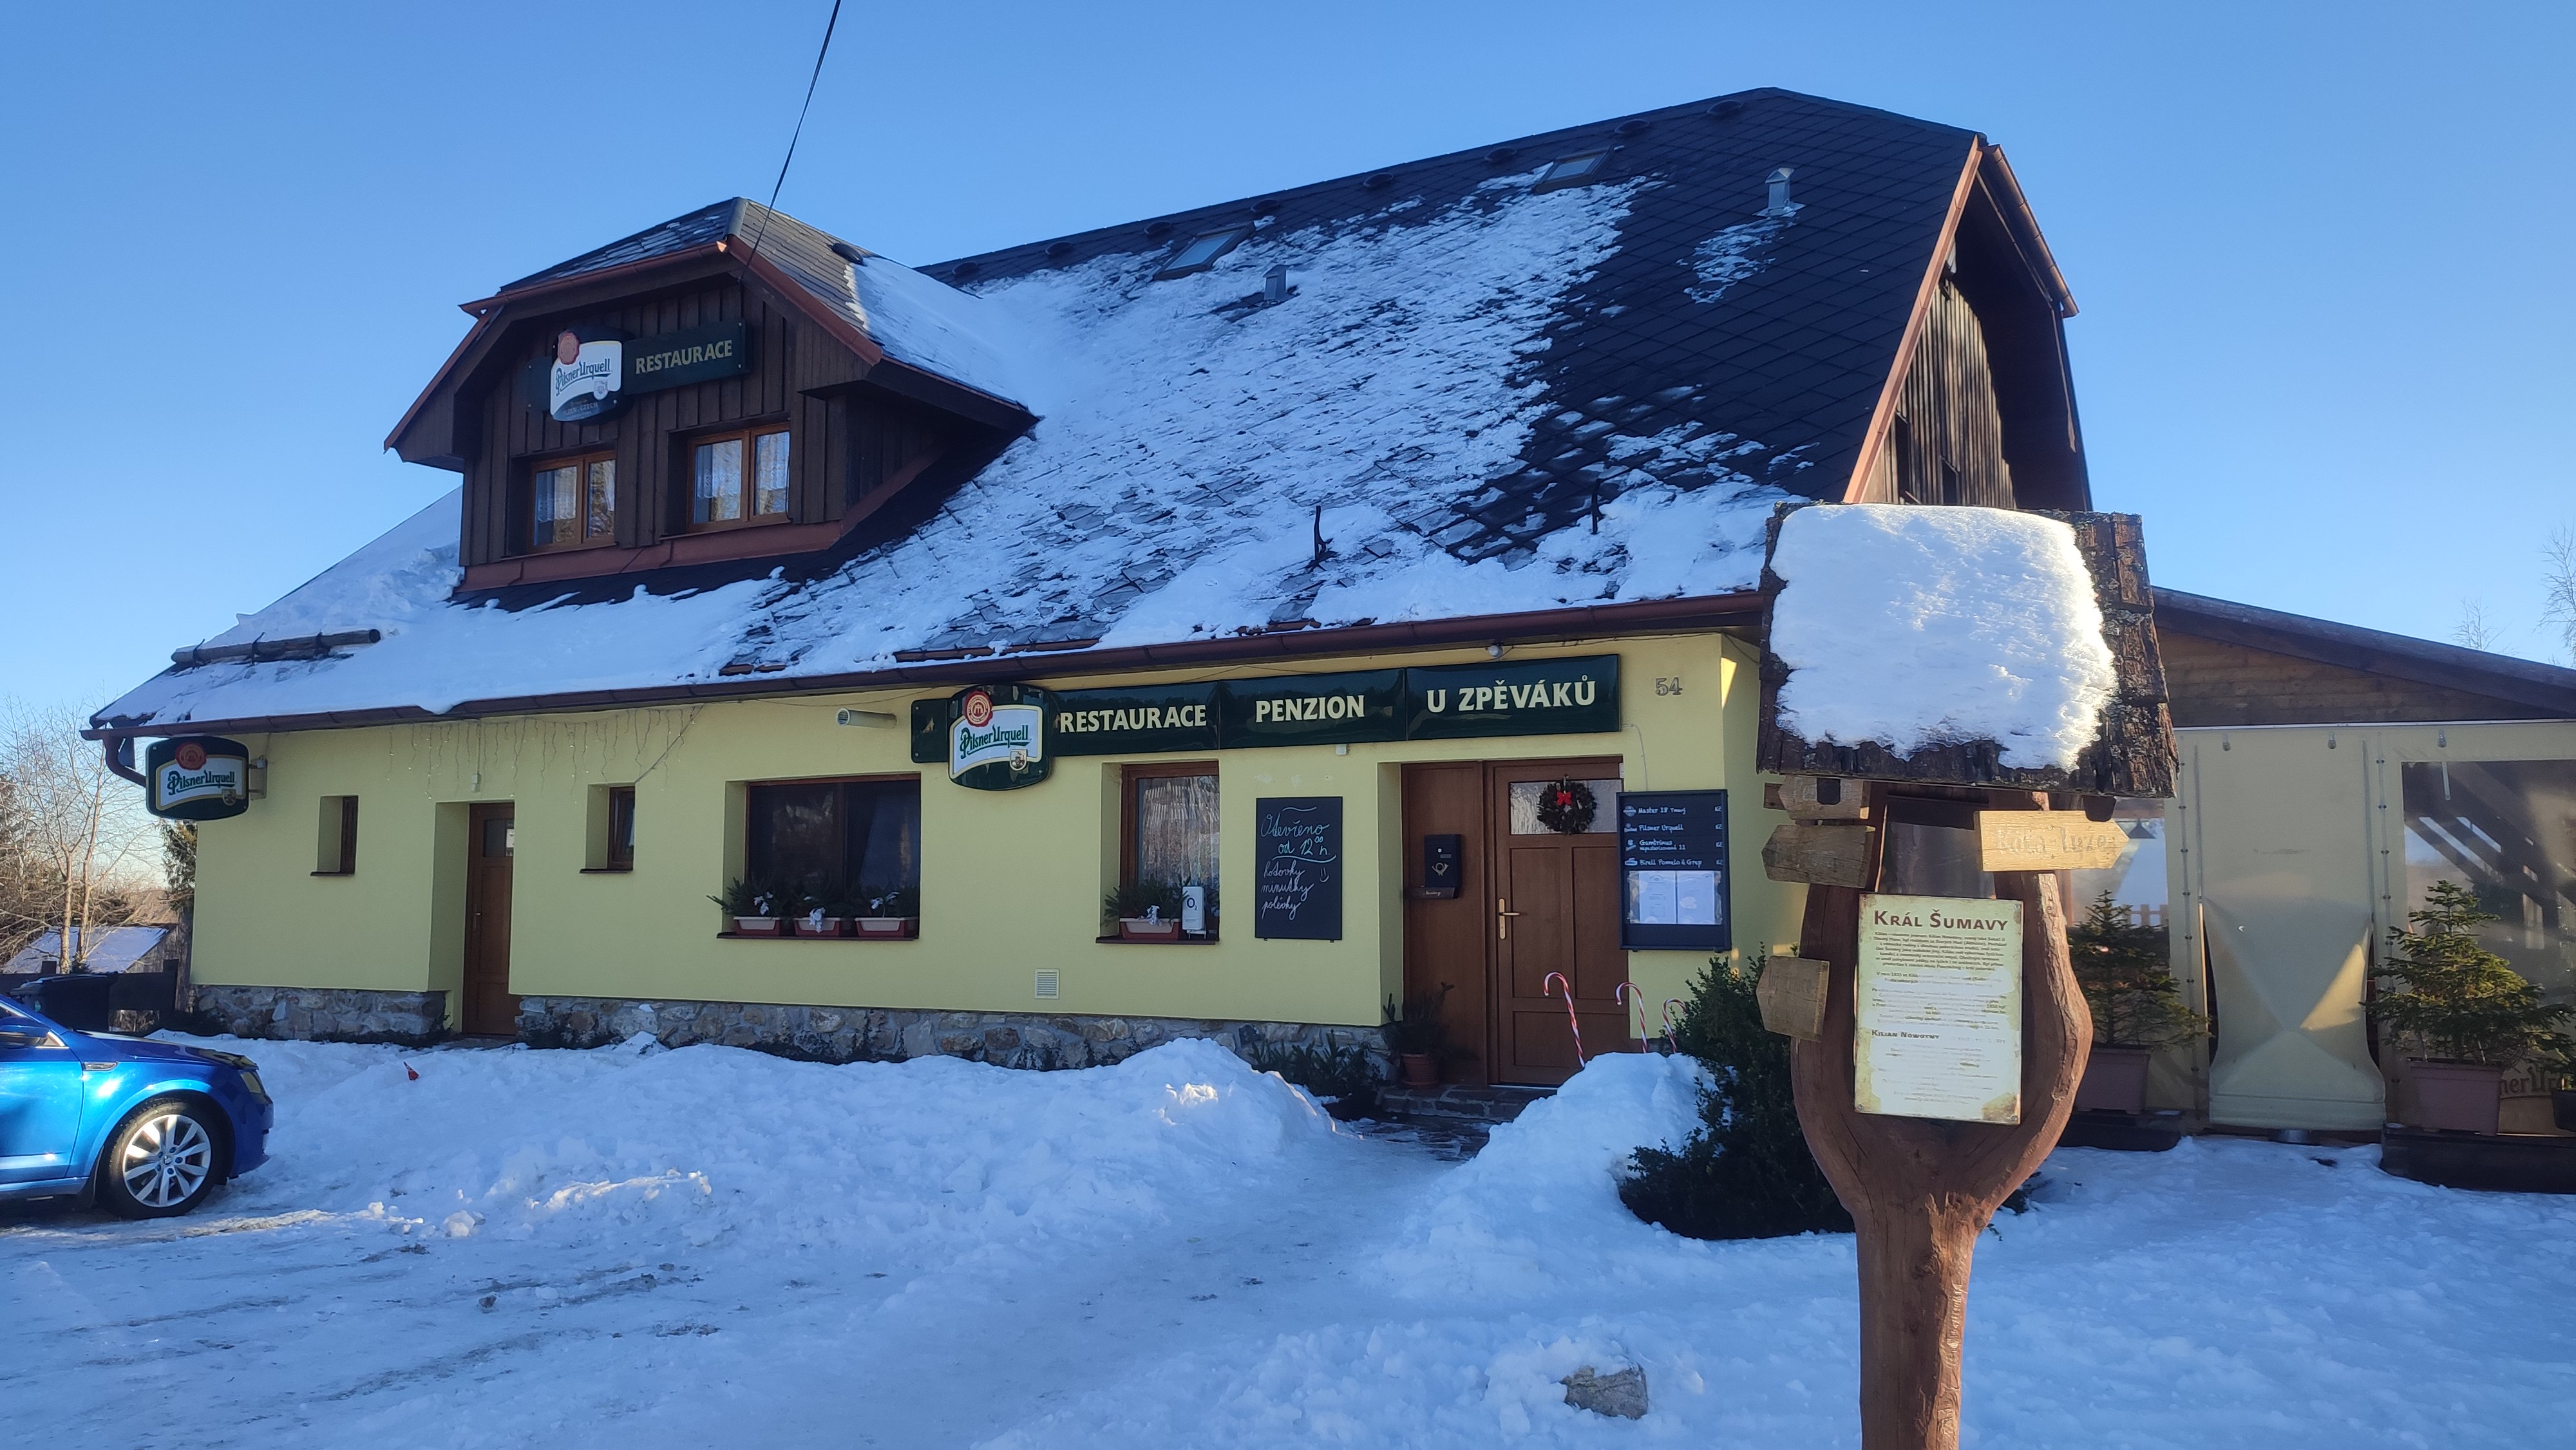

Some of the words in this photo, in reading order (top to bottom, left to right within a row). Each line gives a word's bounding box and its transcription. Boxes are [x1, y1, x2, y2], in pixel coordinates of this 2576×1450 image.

[636, 340, 733, 374] RESTAURACE
[555, 367, 580, 397] Pilsner
[579, 358, 611, 381] Urquell
[1655, 677, 1683, 696] 54
[1060, 704, 1207, 733] RESTAURACE
[1256, 695, 1365, 722] PENZION
[1426, 689, 1446, 713] U
[1458, 675, 1596, 711] ZPĚVÁKŮ
[960, 727, 994, 759] Pilsner
[992, 724, 1028, 749] Urquell
[167, 771, 205, 796] Pilsner
[204, 770, 235, 789] Urquell
[1260, 812, 1331, 837] Otevřeno
[1662, 824, 1684, 834] Urquell
[1278, 840, 1296, 854] od
[1261, 895, 1302, 921] polévky
[1873, 910, 1923, 927] KRÁL
[1929, 909, 2009, 931] ŠUMAVY
